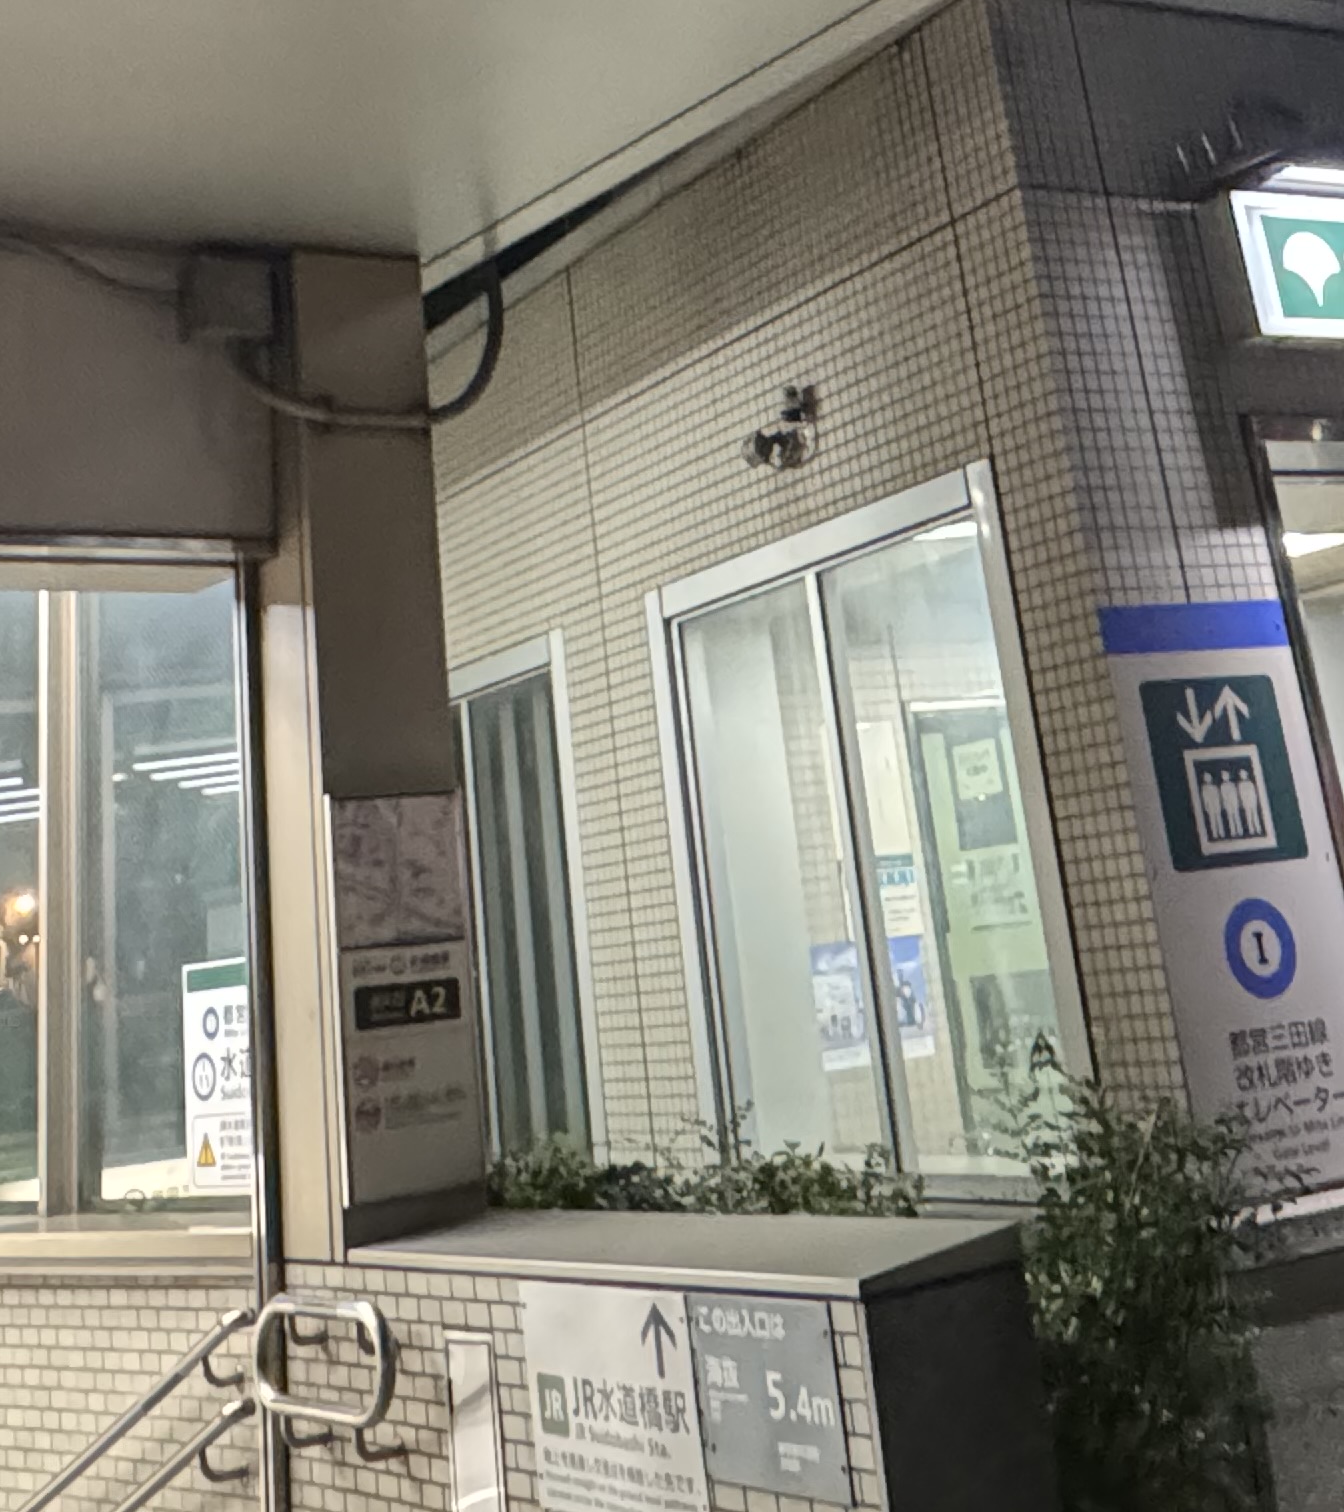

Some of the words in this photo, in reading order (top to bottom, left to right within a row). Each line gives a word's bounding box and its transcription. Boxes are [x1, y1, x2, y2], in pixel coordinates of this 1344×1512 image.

[410, 986, 448, 1019] A2
[544, 1388, 565, 1422] JR
[572, 1375, 691, 1436] JR水道橋駅
[766, 1369, 836, 1427] 5.4m
